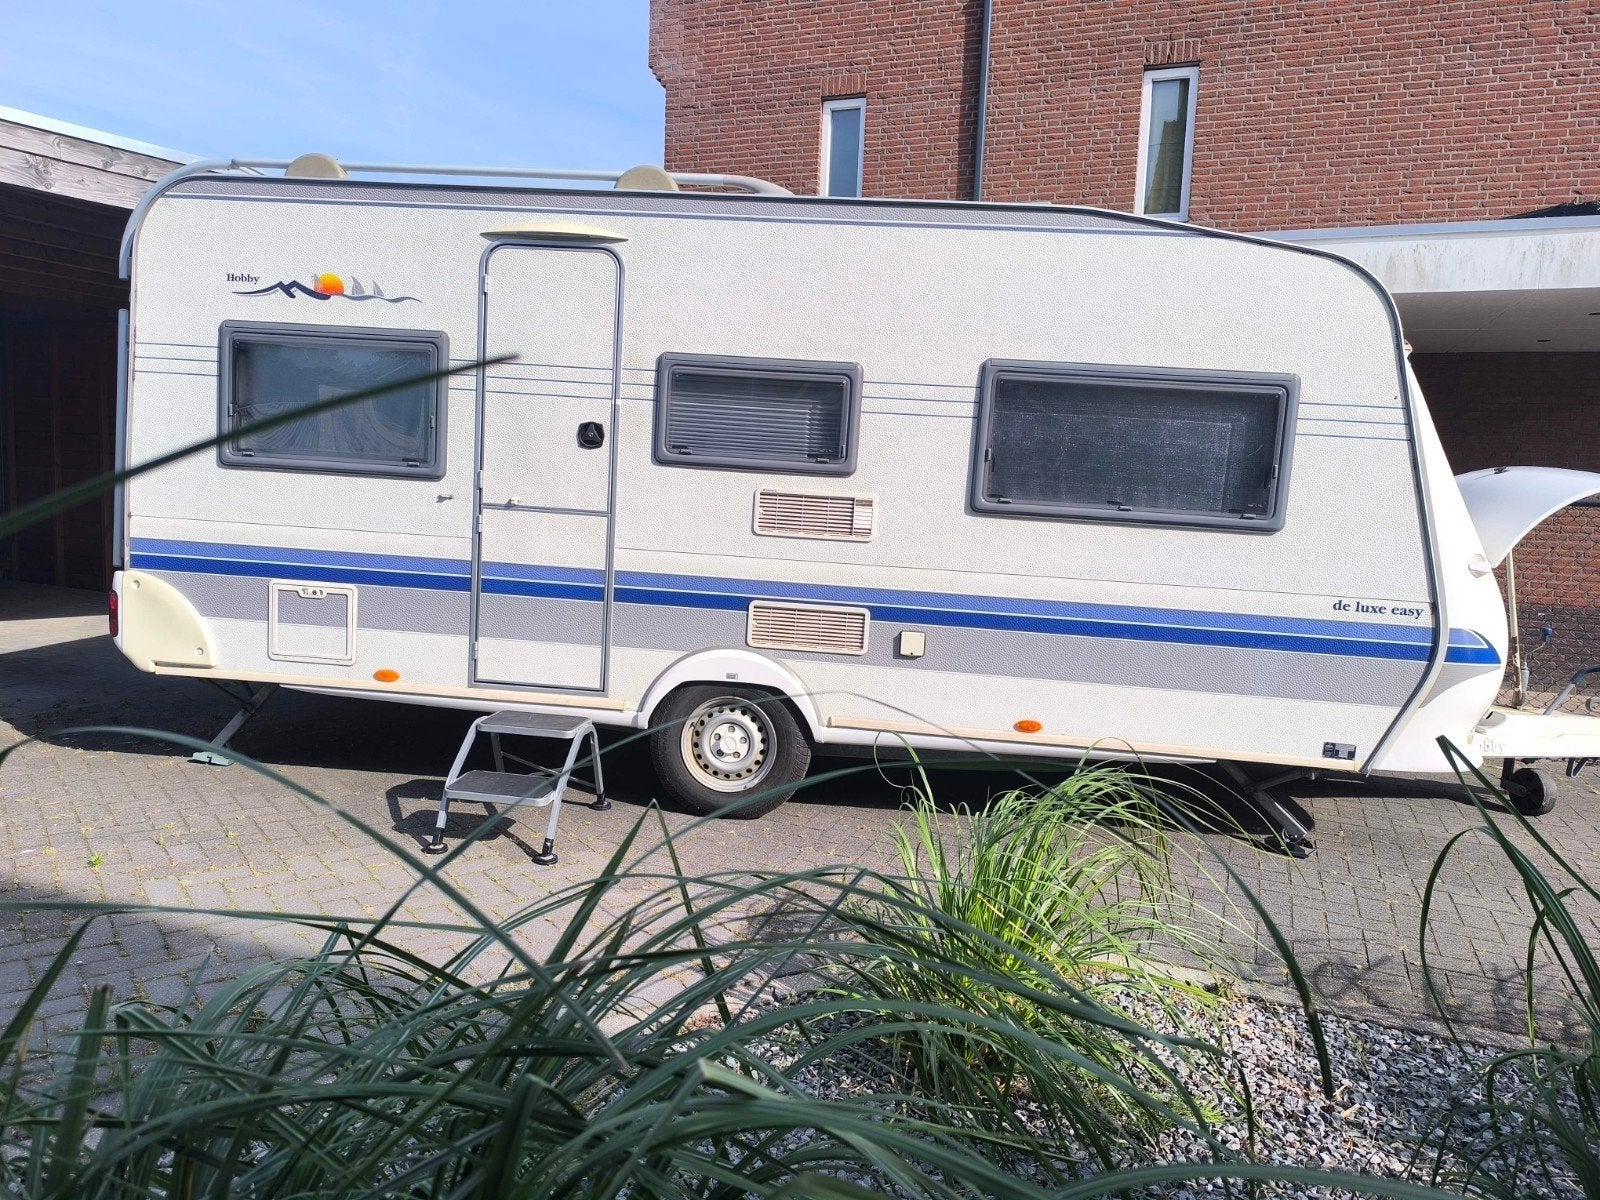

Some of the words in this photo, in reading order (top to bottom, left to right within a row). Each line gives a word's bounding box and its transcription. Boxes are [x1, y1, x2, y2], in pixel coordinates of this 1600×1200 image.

[227, 273, 260, 285] Hobby
[1333, 600, 1351, 611] de
[1355, 601, 1387, 614] luxe
[1391, 607, 1424, 619] easy
